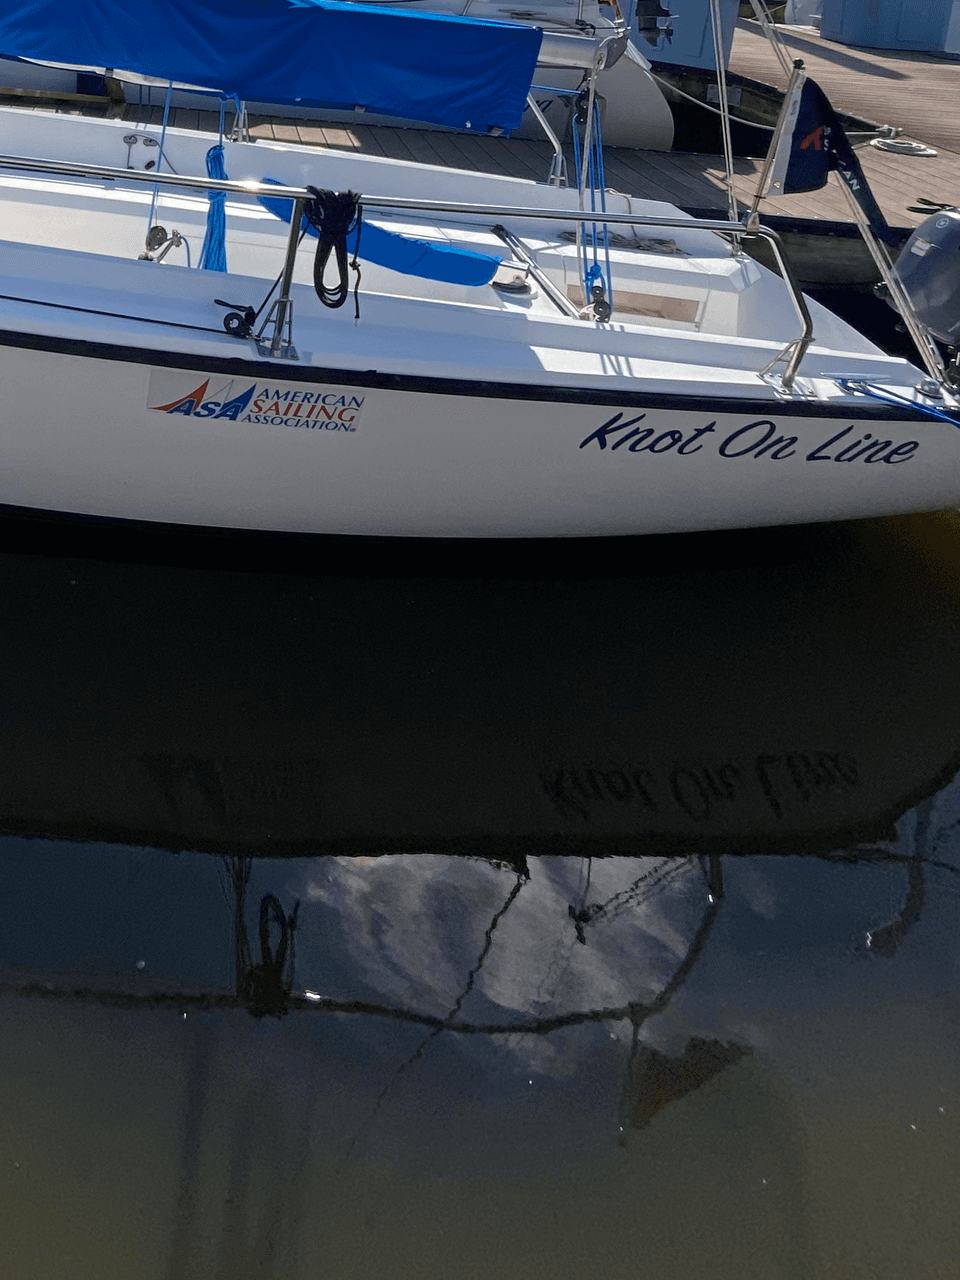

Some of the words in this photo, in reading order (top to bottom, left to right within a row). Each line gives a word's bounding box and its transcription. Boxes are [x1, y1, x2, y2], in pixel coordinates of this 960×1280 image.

[256, 388, 365, 408] AMERICAN
[249, 399, 357, 422] SAILING
[579, 411, 717, 456] Knot
[719, 420, 798, 461] On
[805, 424, 920, 465] Line
